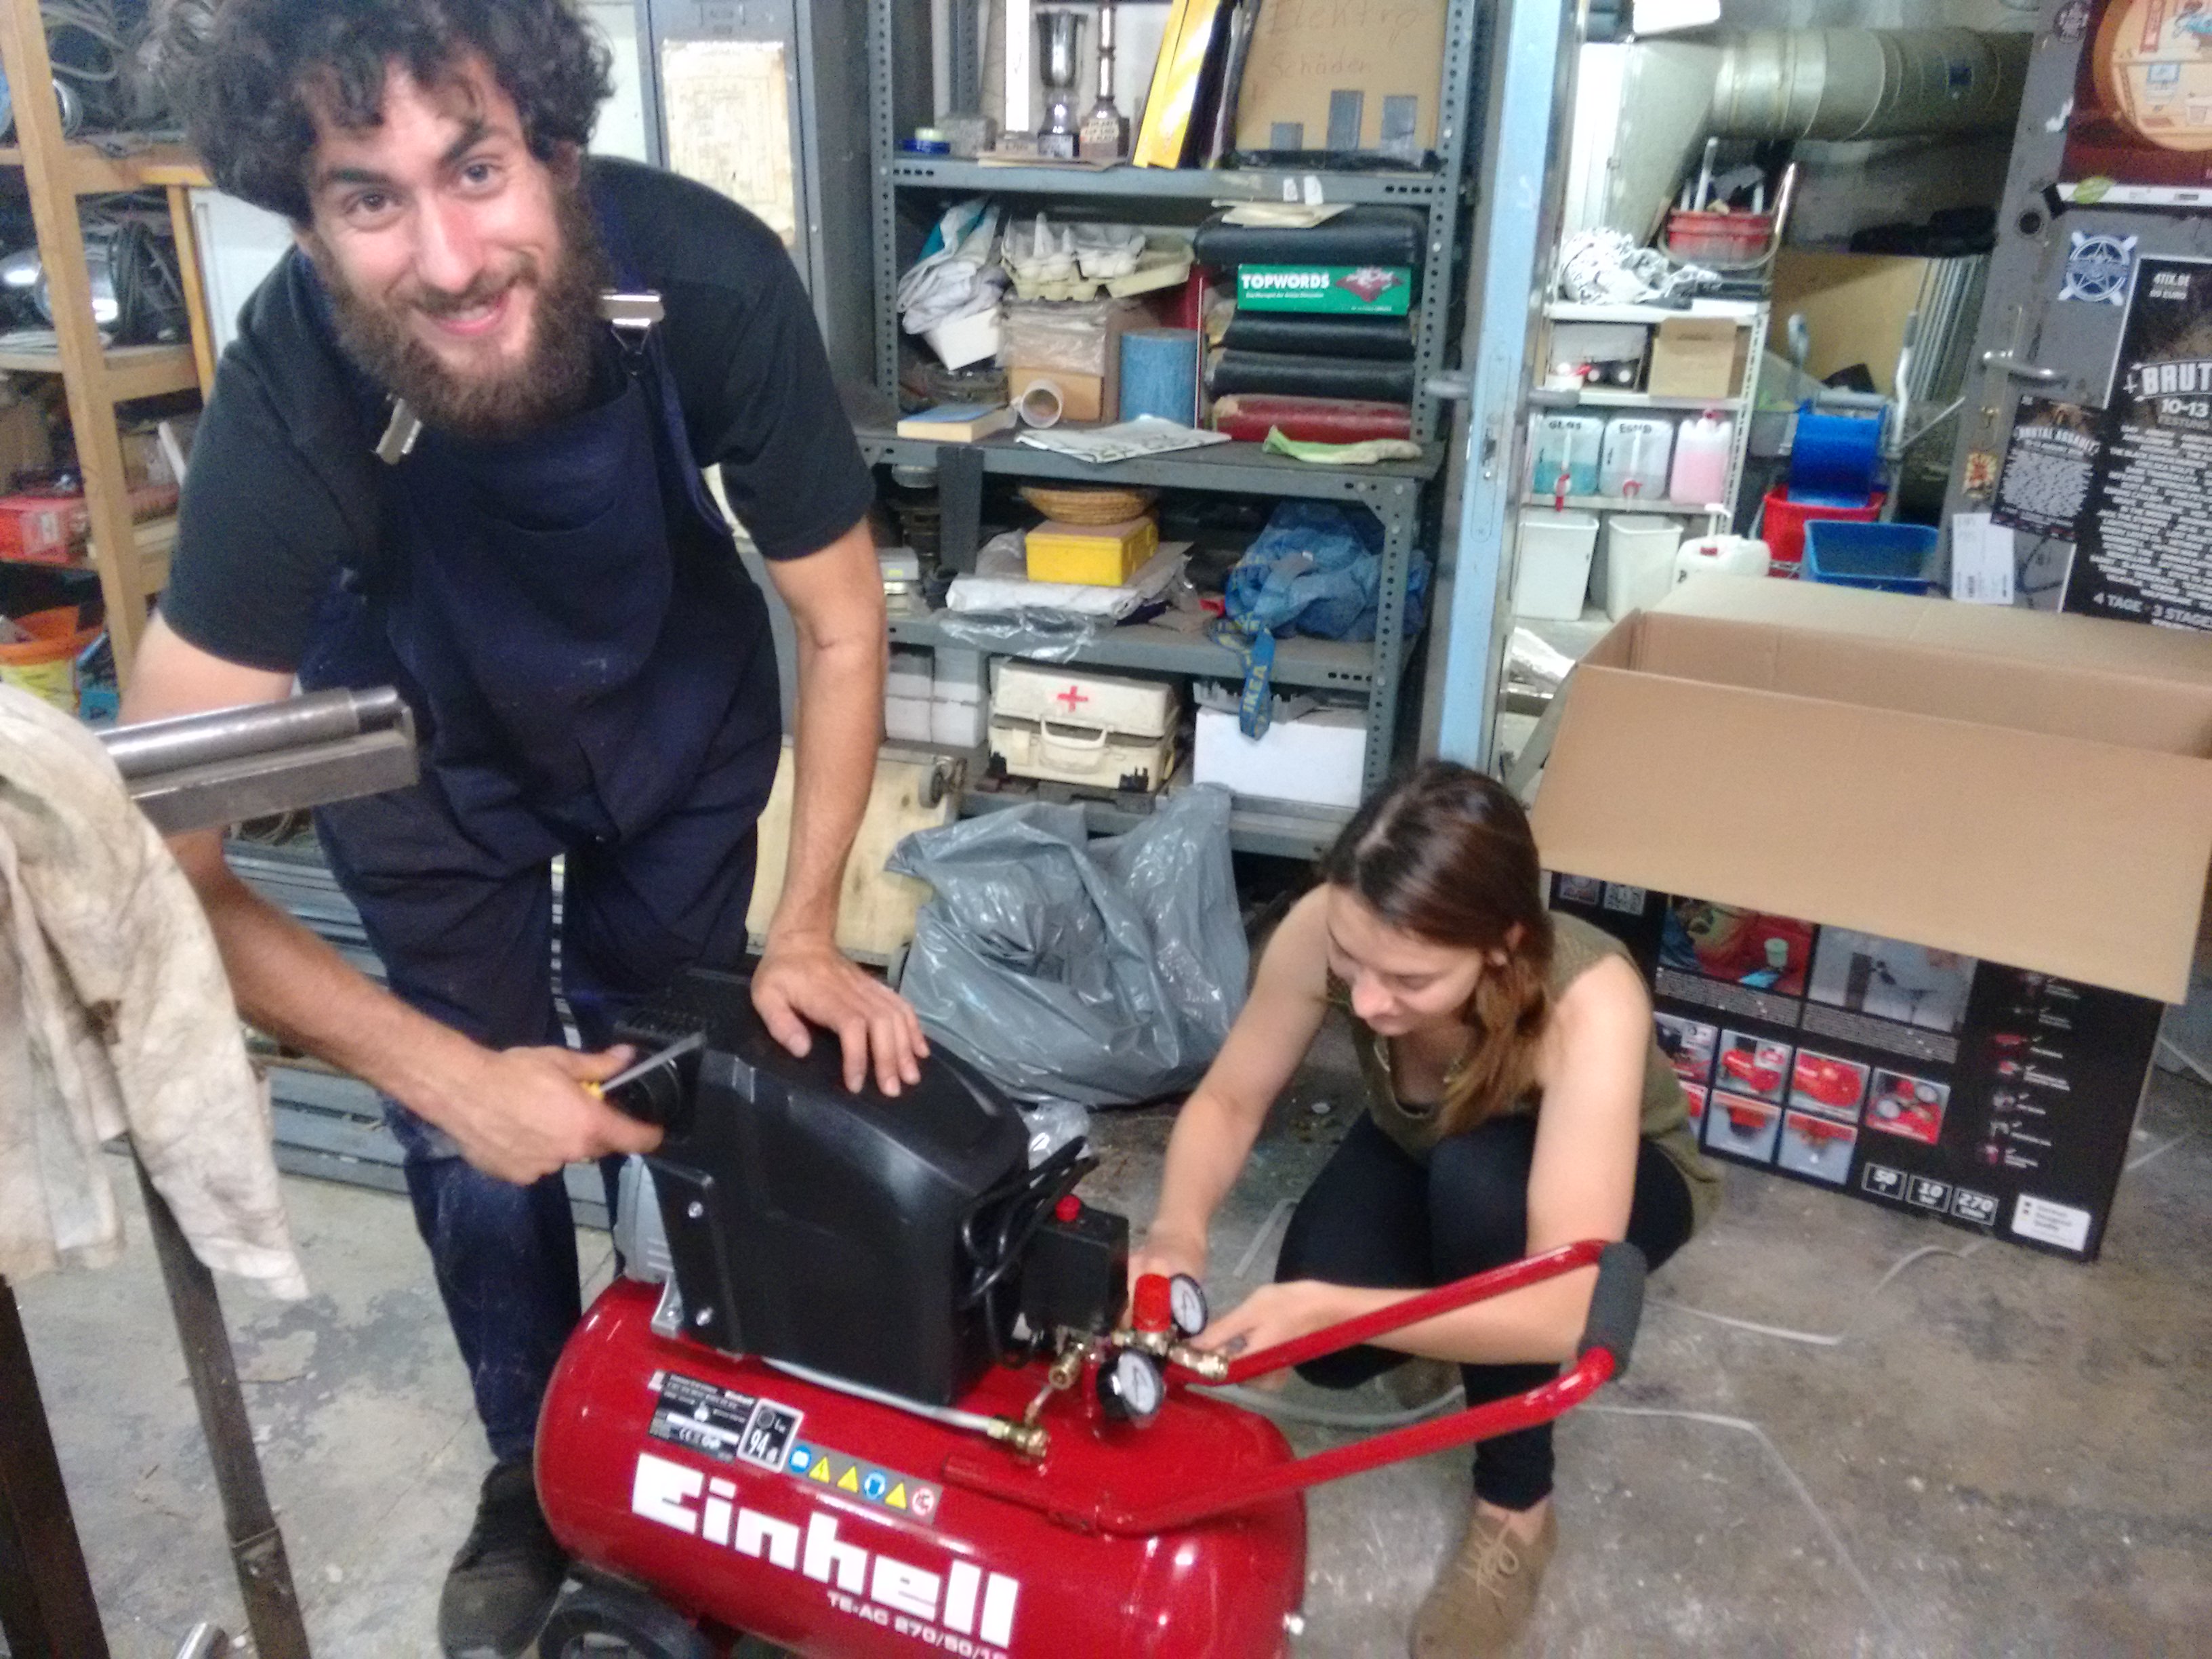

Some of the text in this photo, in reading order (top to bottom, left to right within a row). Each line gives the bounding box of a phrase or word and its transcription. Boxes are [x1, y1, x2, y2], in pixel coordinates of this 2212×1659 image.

[1242, 273, 1330, 289] TOPWORDS
[2161, 398, 2209, 418] 10-13
[1242, 665, 1268, 714] IKEA
[1873, 1168, 1897, 1186] 50
[1958, 1193, 1994, 1212] 270
[748, 1428, 772, 1459] 94
[632, 1452, 1019, 1650] Einhell
